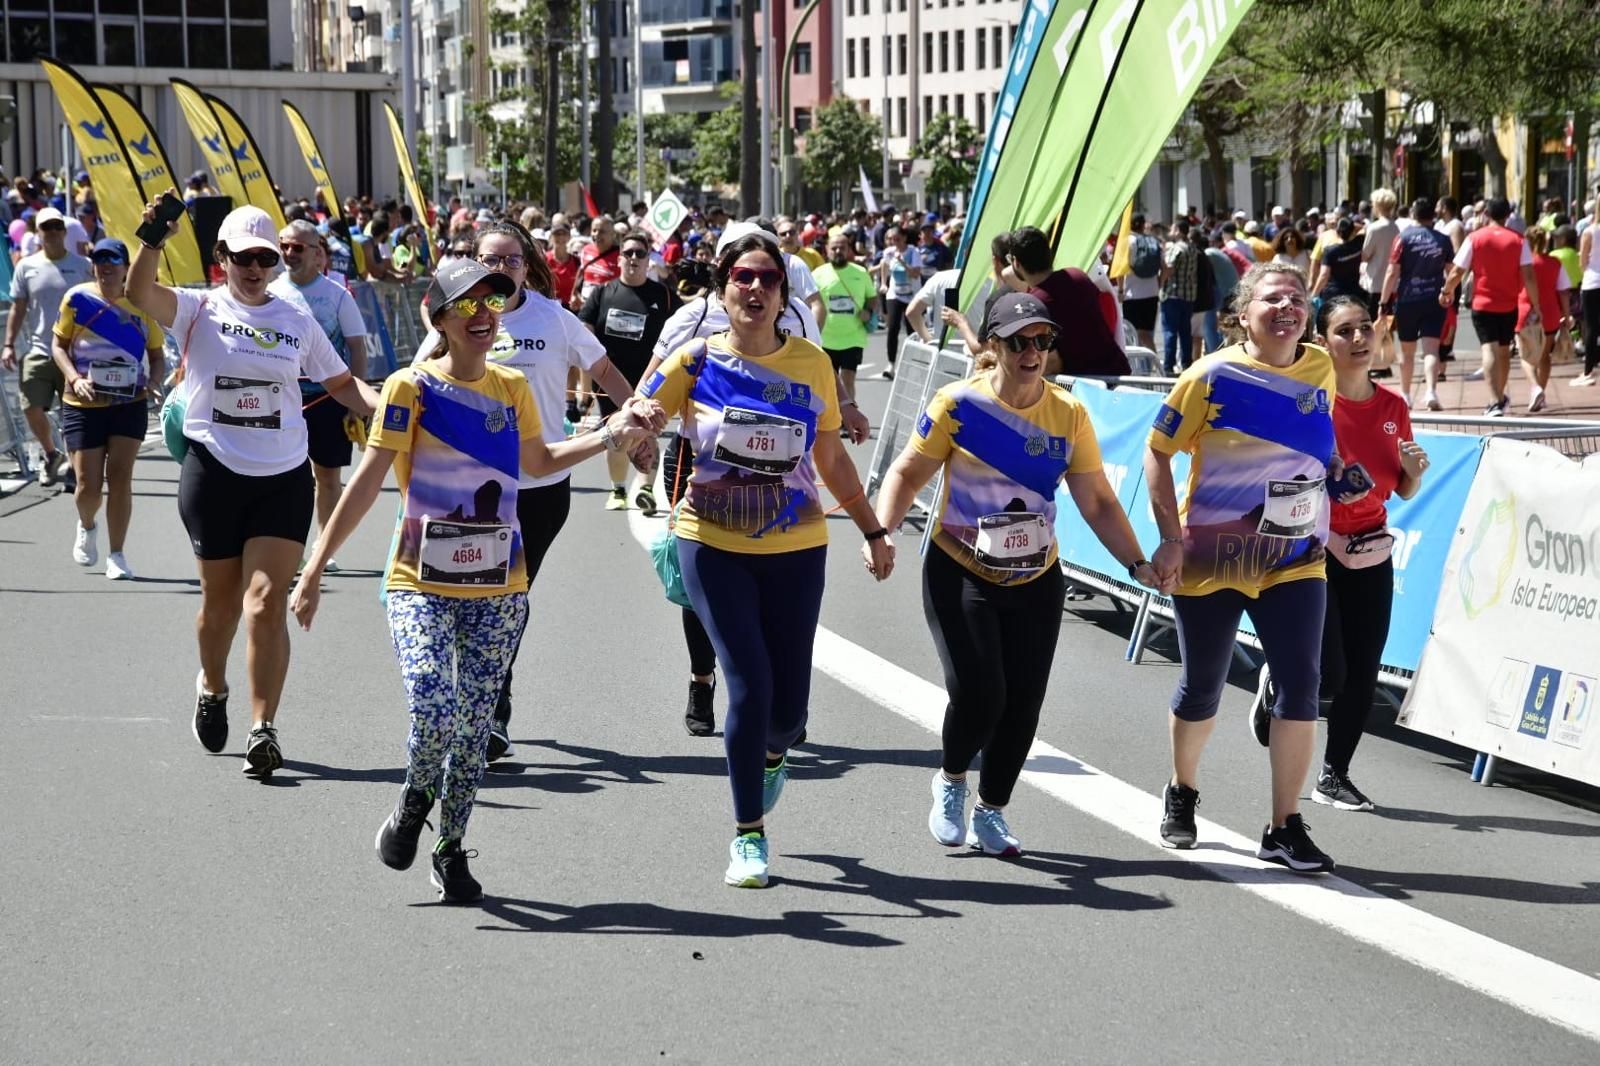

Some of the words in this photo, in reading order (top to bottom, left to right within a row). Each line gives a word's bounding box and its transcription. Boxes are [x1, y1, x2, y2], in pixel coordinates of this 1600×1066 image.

[222, 322, 255, 337] PRO
[276, 332, 300, 350] PRO
[514, 339, 546, 351] PRO
[237, 397, 260, 410] 4492
[747, 437, 775, 452] 4781
[1291, 502, 1311, 518] 4736
[1004, 534, 1029, 549] 4738
[1525, 513, 1585, 576] Gran
[453, 548, 482, 563] 4684
[1511, 577, 1537, 608] Isla
[1538, 583, 1598, 622] Europea
